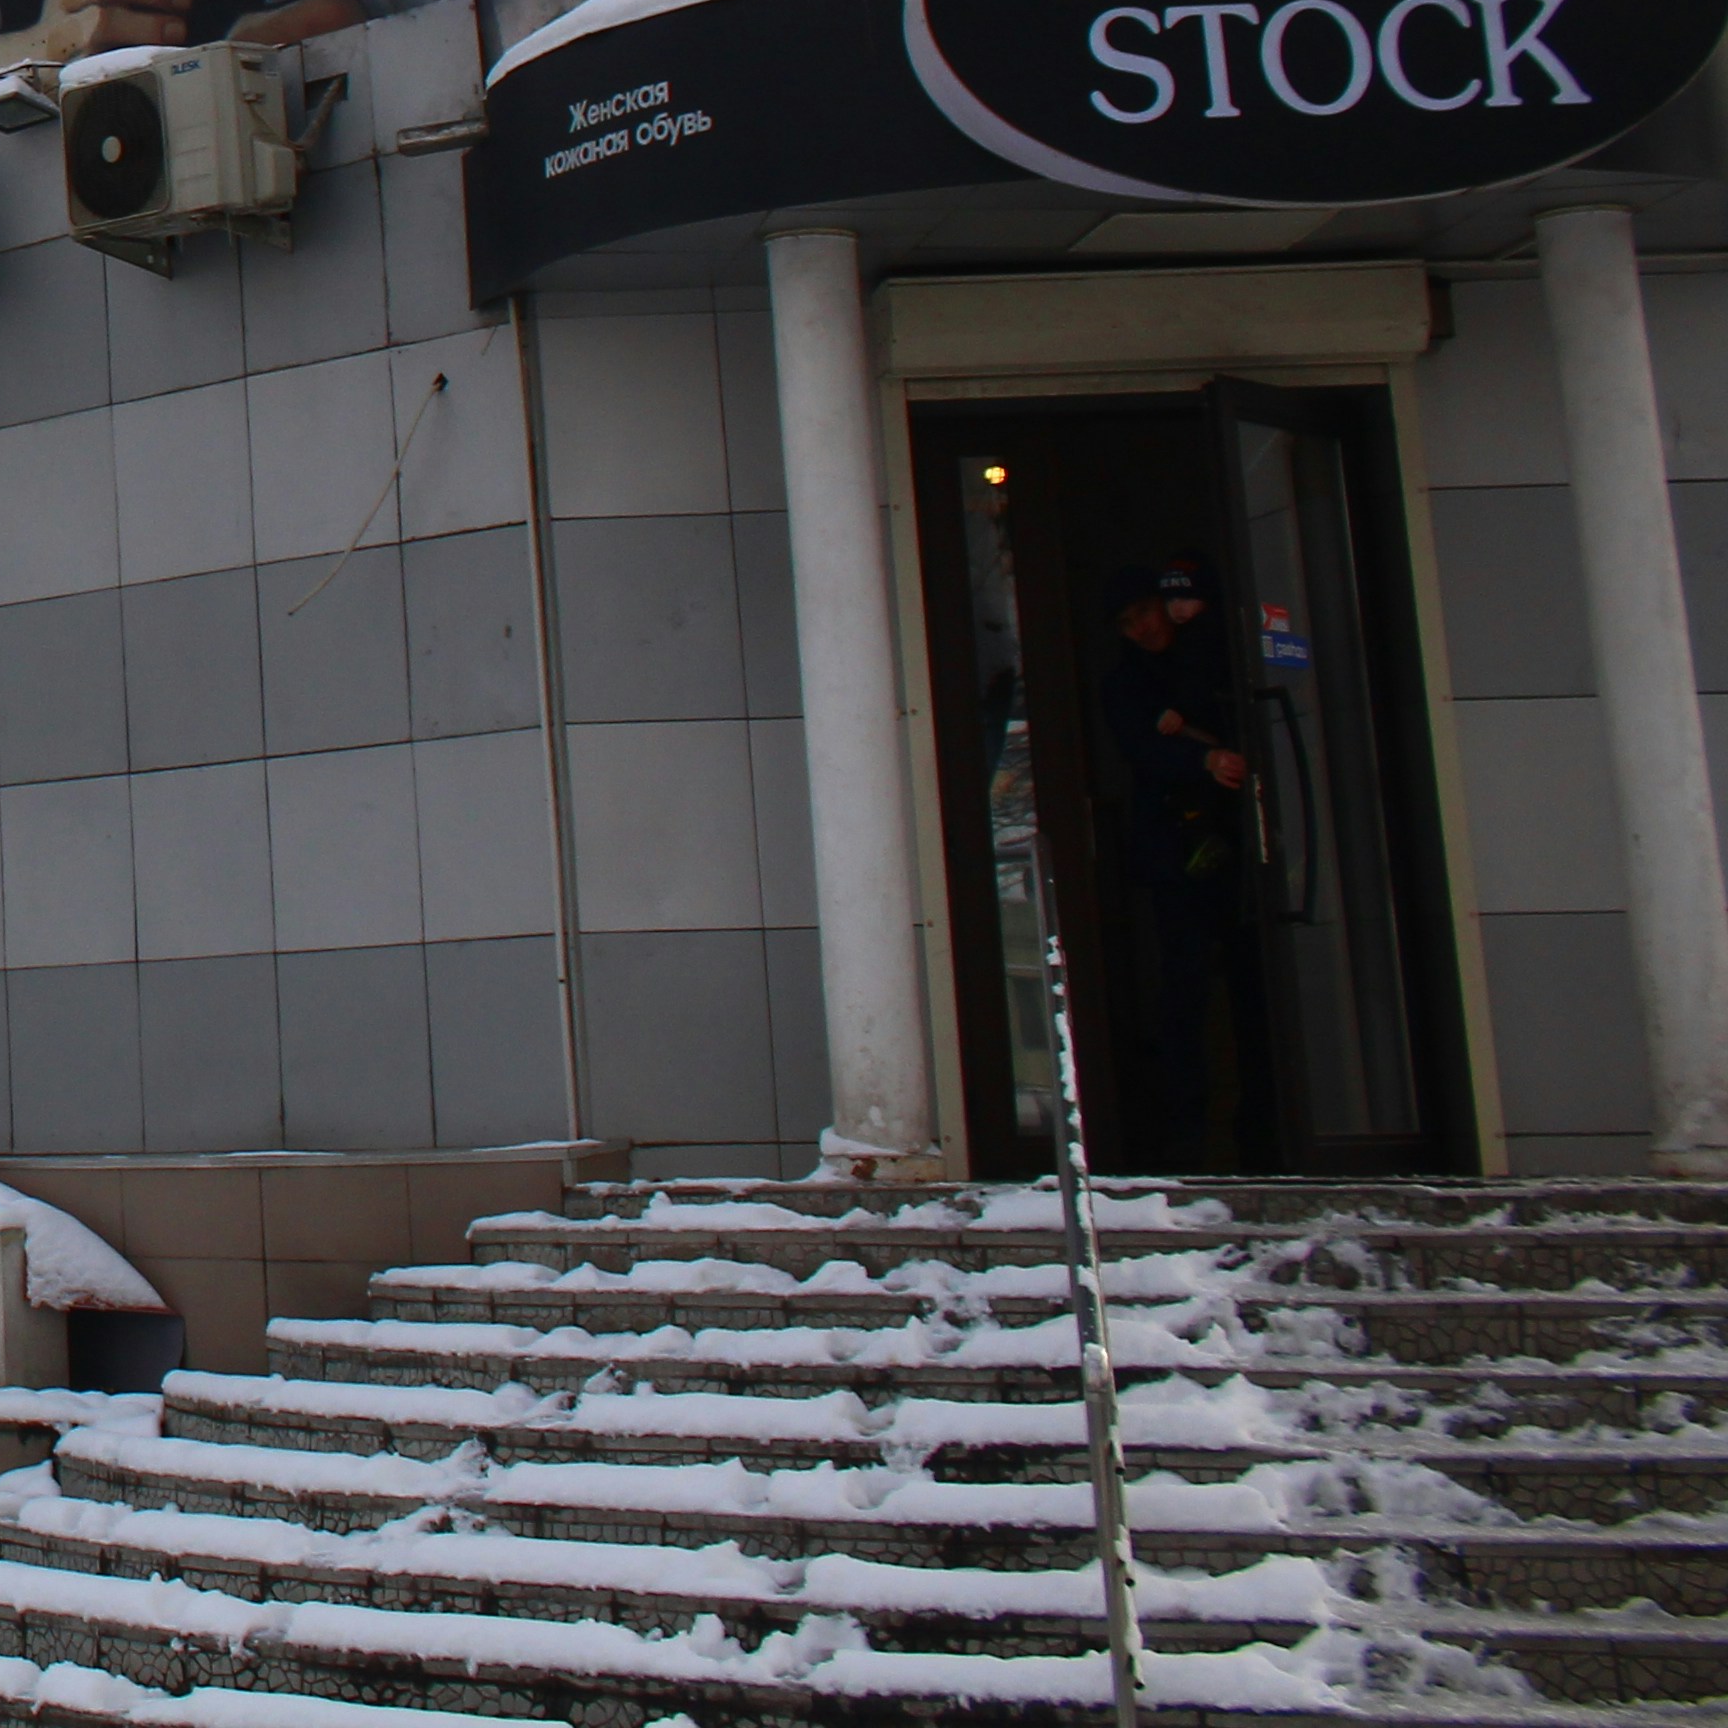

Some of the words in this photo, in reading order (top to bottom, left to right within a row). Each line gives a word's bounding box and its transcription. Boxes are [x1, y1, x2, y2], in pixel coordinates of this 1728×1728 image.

[568, 80, 671, 133] Женская
[543, 129, 630, 179] кожаная
[636, 109, 713, 147] обувь
